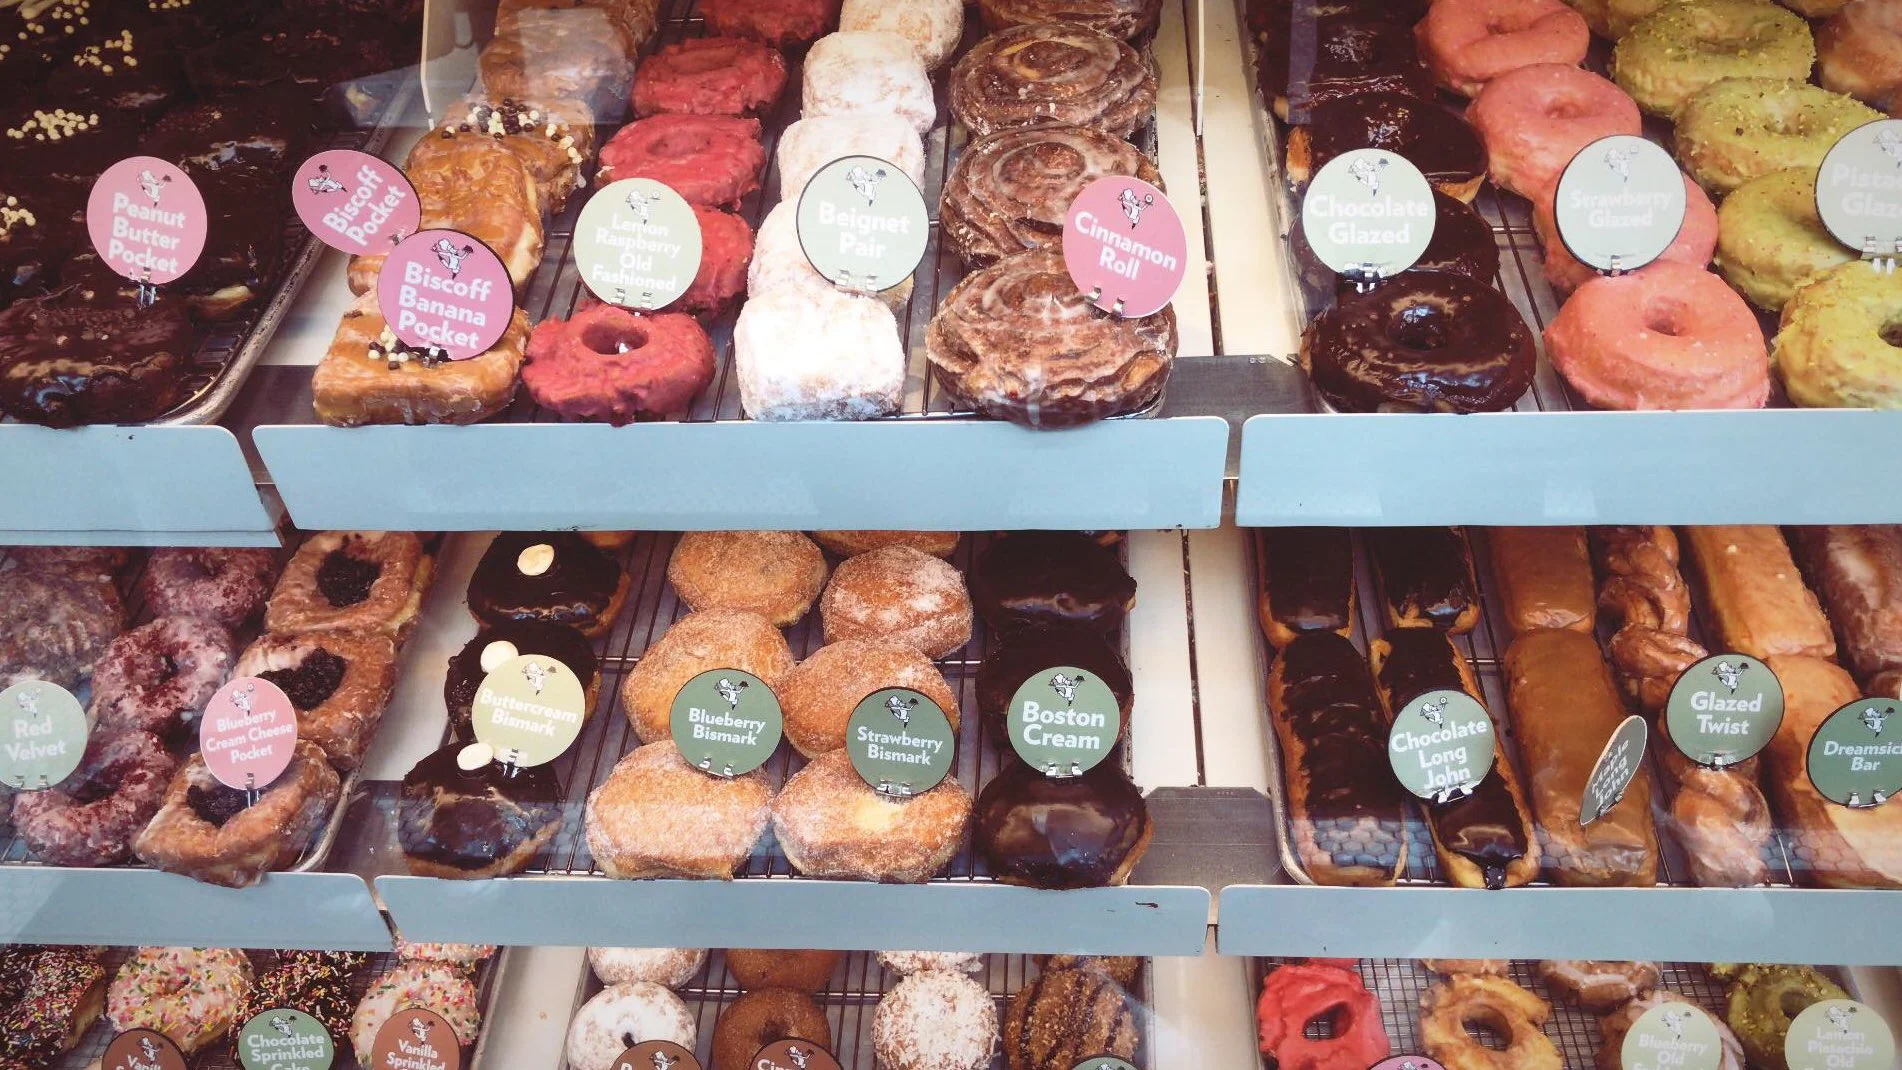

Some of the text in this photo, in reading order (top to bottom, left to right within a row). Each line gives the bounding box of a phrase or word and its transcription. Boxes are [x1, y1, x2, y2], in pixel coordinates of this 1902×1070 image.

[112, 191, 186, 230] Peanut
[322, 164, 384, 233] Biscoff
[1309, 194, 1429, 219] Chocolate
[1570, 188, 1673, 212] Strawberry
[345, 185, 406, 246] Pocket
[611, 212, 669, 238] Lemon
[819, 201, 911, 235] Beignet
[1588, 206, 1653, 229] Glazed
[112, 217, 180, 251] Butter
[595, 227, 682, 259] Raspberry
[839, 231, 886, 260] Pair
[1074, 211, 1177, 272] Cinnamon
[1328, 221, 1411, 246] Glazed
[108, 239, 178, 275] Pocket
[619, 252, 653, 272] Old
[1099, 248, 1140, 281] Roll
[405, 261, 493, 302] Biscoff
[592, 263, 677, 293] Fashioned
[399, 285, 486, 327] Banana
[399, 310, 480, 349] Pocket
[480, 688, 577, 723] Buttercream
[1691, 691, 1763, 712] Glazed
[216, 708, 277, 733] Blueberry
[491, 708, 556, 737] Bismark
[688, 707, 766, 734] Blueberry
[1022, 701, 1105, 728] Boston
[1697, 714, 1749, 735] Twist
[14, 717, 52, 739] Red
[206, 722, 293, 752] Cream Cheese
[693, 724, 757, 746] Bismark
[857, 726, 943, 752] Strawberry
[1023, 724, 1100, 749] Cream
[1391, 720, 1487, 753] Chocolate
[4, 739, 67, 762] Velvet
[230, 744, 273, 763] Pocket
[867, 744, 931, 765] Bismark
[1418, 746, 1467, 769] Long
[1823, 740, 1902, 756] Dreamsic
[1851, 756, 1880, 771] Bar
[1424, 765, 1470, 789] John
[1596, 771, 1629, 811] John
[247, 1032, 325, 1048] Chocolate
[1638, 1033, 1709, 1056] Blueberry
[1816, 1026, 1865, 1041] Lemon
[251, 1045, 325, 1065] Sprinkled
[398, 1039, 438, 1059] Vanilla
[1656, 1050, 1685, 1065] Old
[1807, 1038, 1874, 1056] Pistachio
[1827, 1053, 1855, 1069] Old
